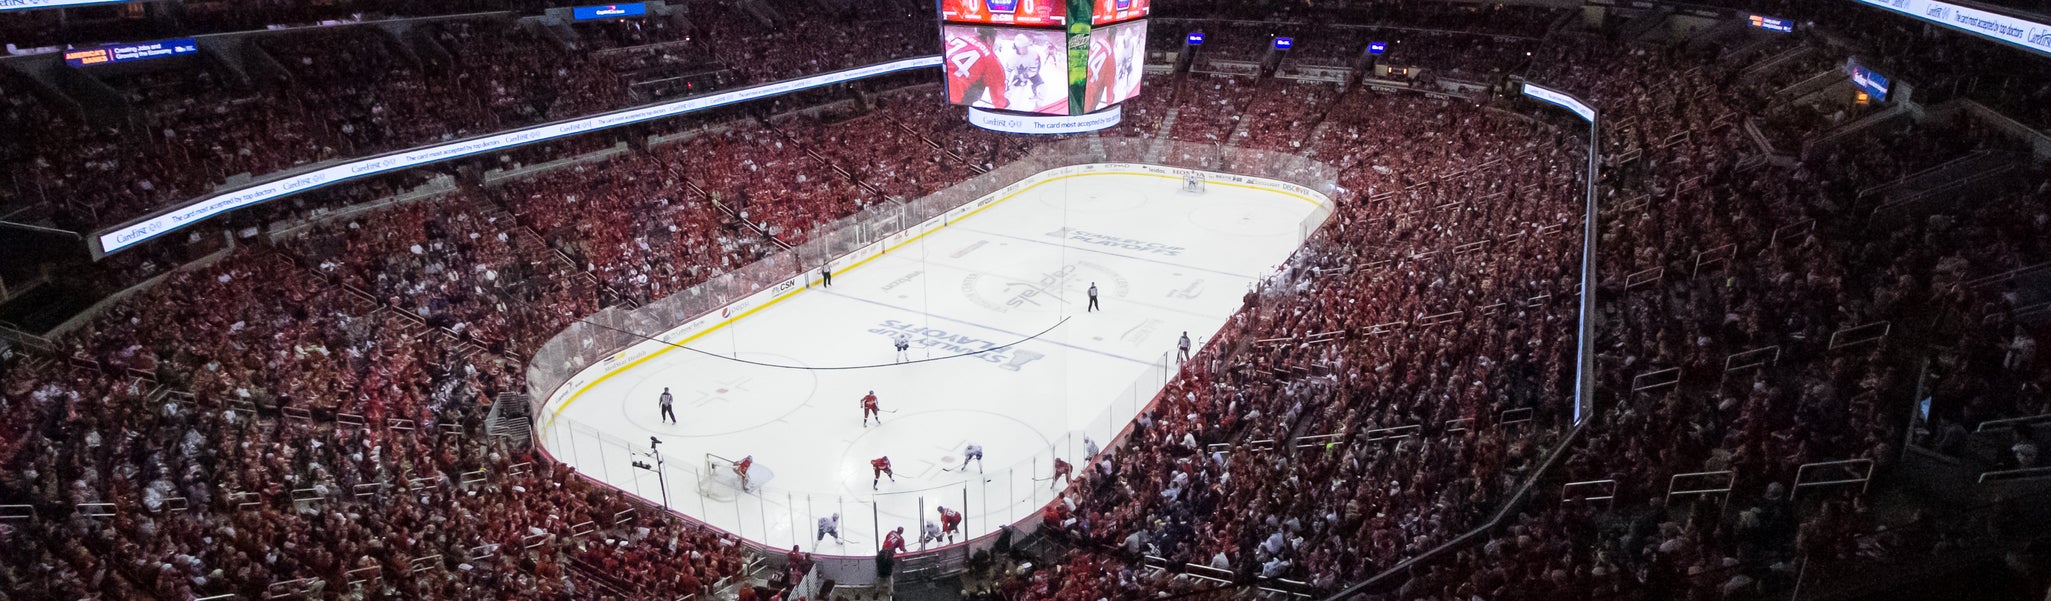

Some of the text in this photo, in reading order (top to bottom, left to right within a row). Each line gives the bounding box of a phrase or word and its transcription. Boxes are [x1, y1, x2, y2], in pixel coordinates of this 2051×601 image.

[1034, 121, 1045, 129] The
[1046, 121, 1060, 129] card
[1061, 120, 1076, 128] most
[351, 162, 380, 173] CareFirst
[283, 177, 311, 191] CareFirst
[172, 215, 183, 223] The
[184, 210, 195, 220] card
[196, 205, 209, 215] most
[209, 198, 234, 211] accepted
[243, 193, 254, 203] top
[254, 187, 277, 198] doctors
[117, 226, 147, 243] CareFirst
[780, 279, 795, 291] CSN
